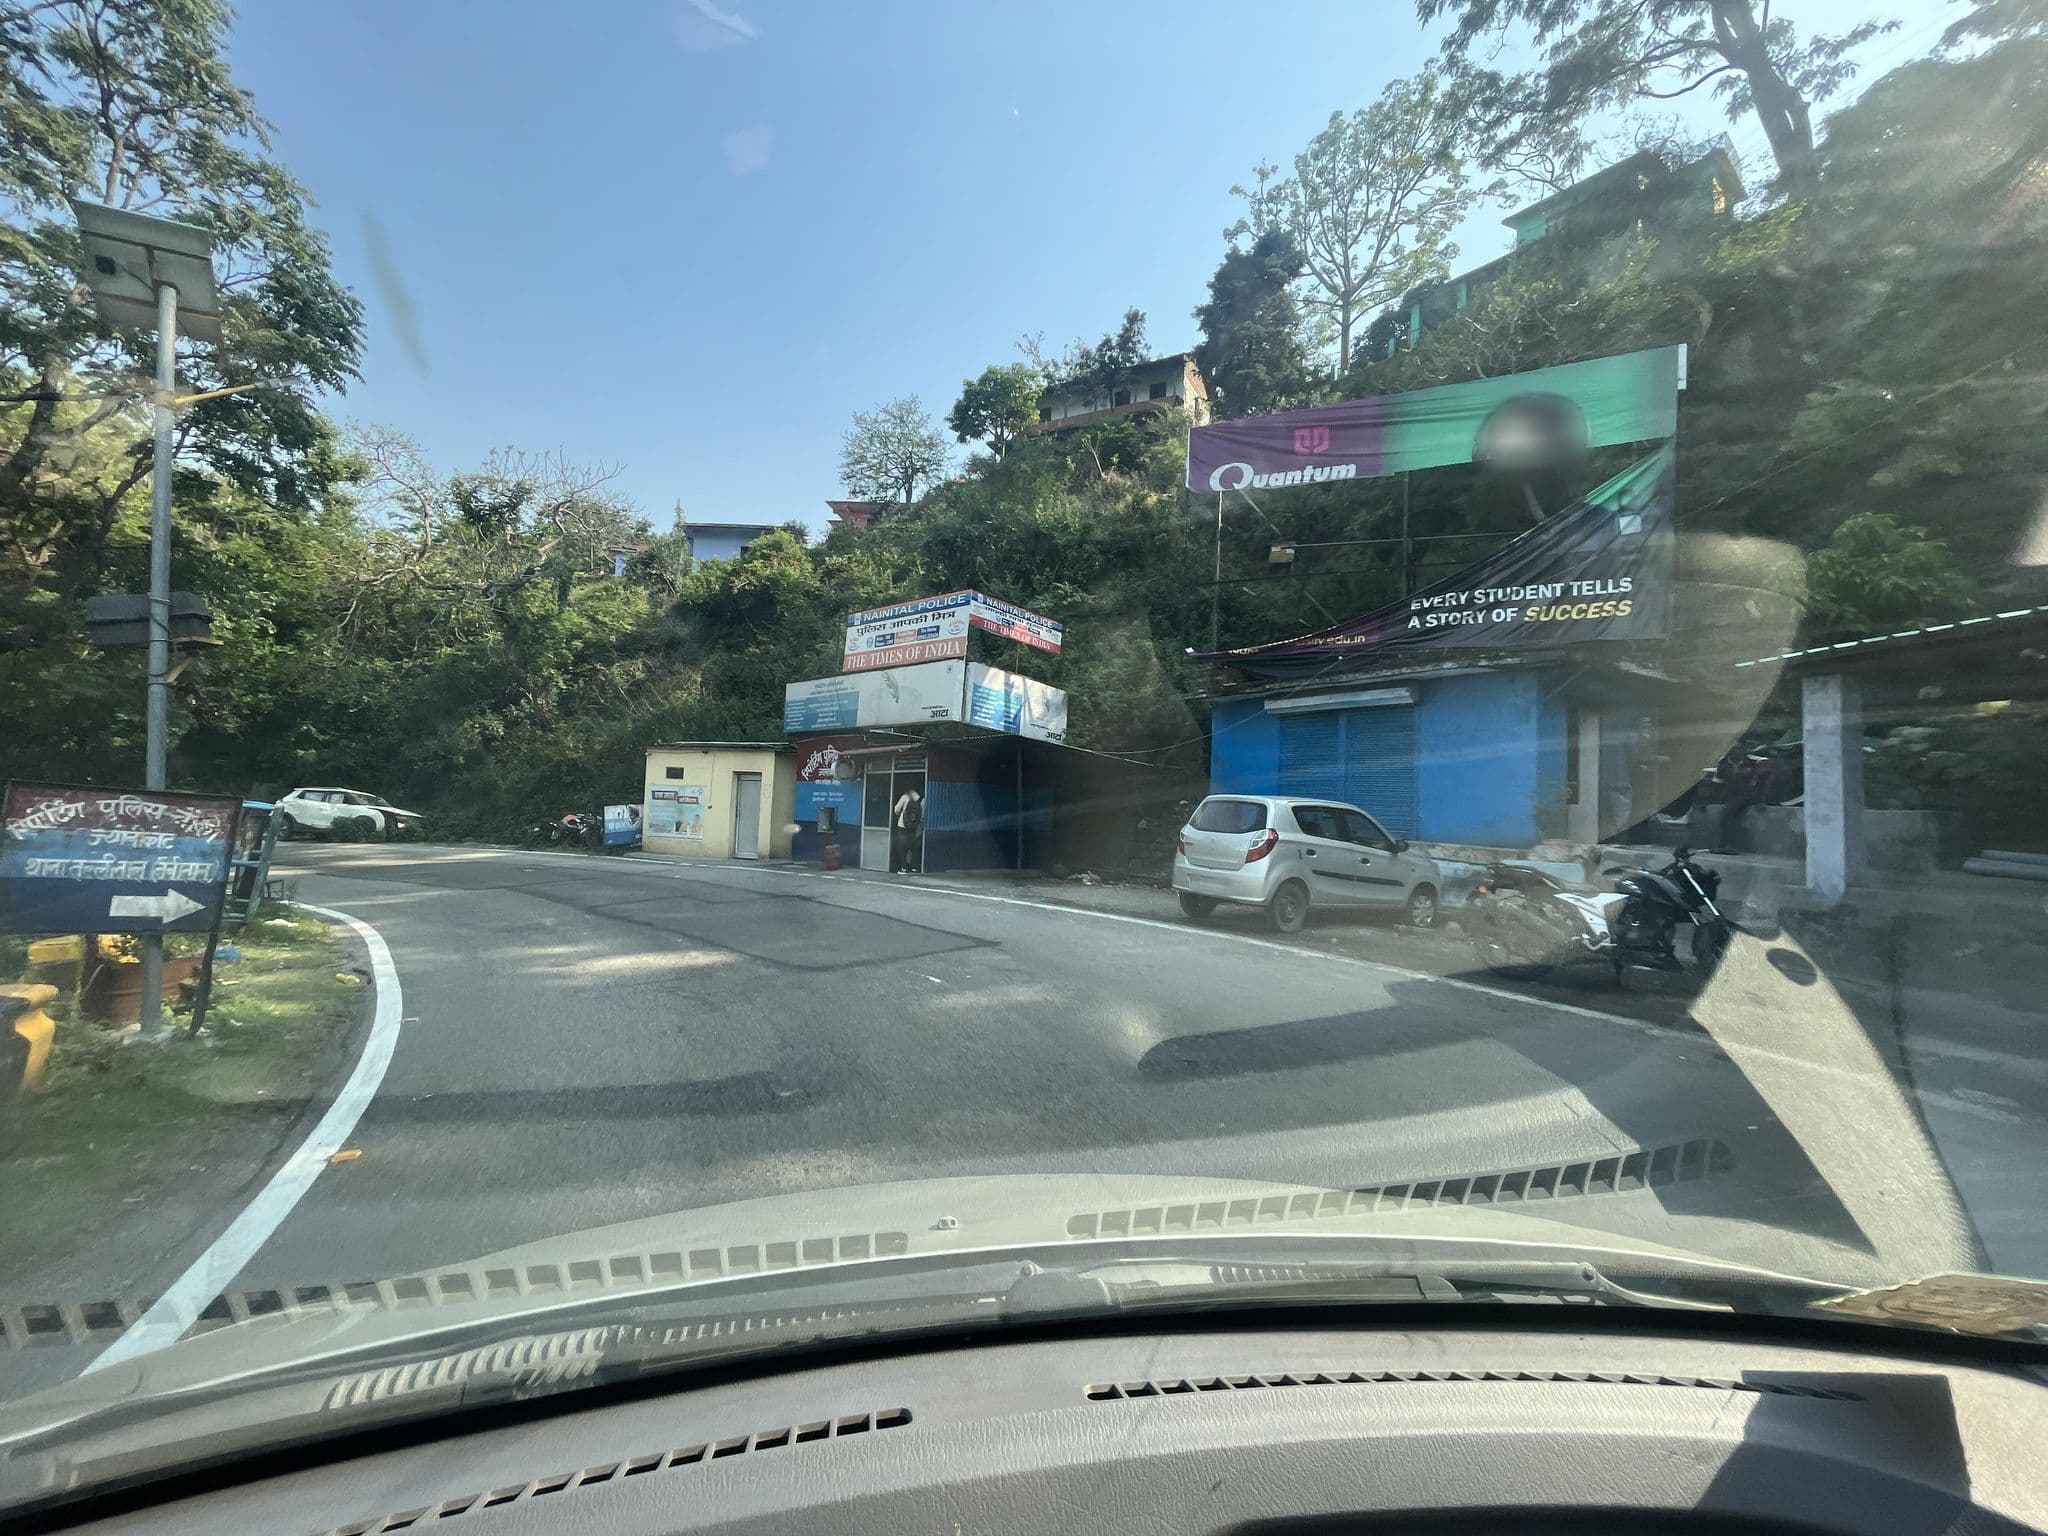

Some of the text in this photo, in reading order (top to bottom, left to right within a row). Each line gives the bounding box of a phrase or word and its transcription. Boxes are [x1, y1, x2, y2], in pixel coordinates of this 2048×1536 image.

[1209, 462, 1357, 491] Quantum
[864, 593, 967, 622] NAINITAL POLICE
[1410, 577, 1633, 611] EVERY STUDENT TELLS
[856, 621, 887, 636] पुलिस
[889, 614, 928, 629] आपकी
[931, 610, 957, 622] मित्र
[986, 597, 1024, 617] NAINITAL
[1025, 612, 1053, 628] POLICE
[1407, 600, 1633, 629] A STORY OF SUCCESS
[983, 620, 998, 632] THE
[1021, 634, 1031, 643] OF
[1032, 636, 1050, 650] INDIA
[847, 641, 961, 669] THE TIMES OF INDIA
[96, 794, 168, 821] पुलिस
